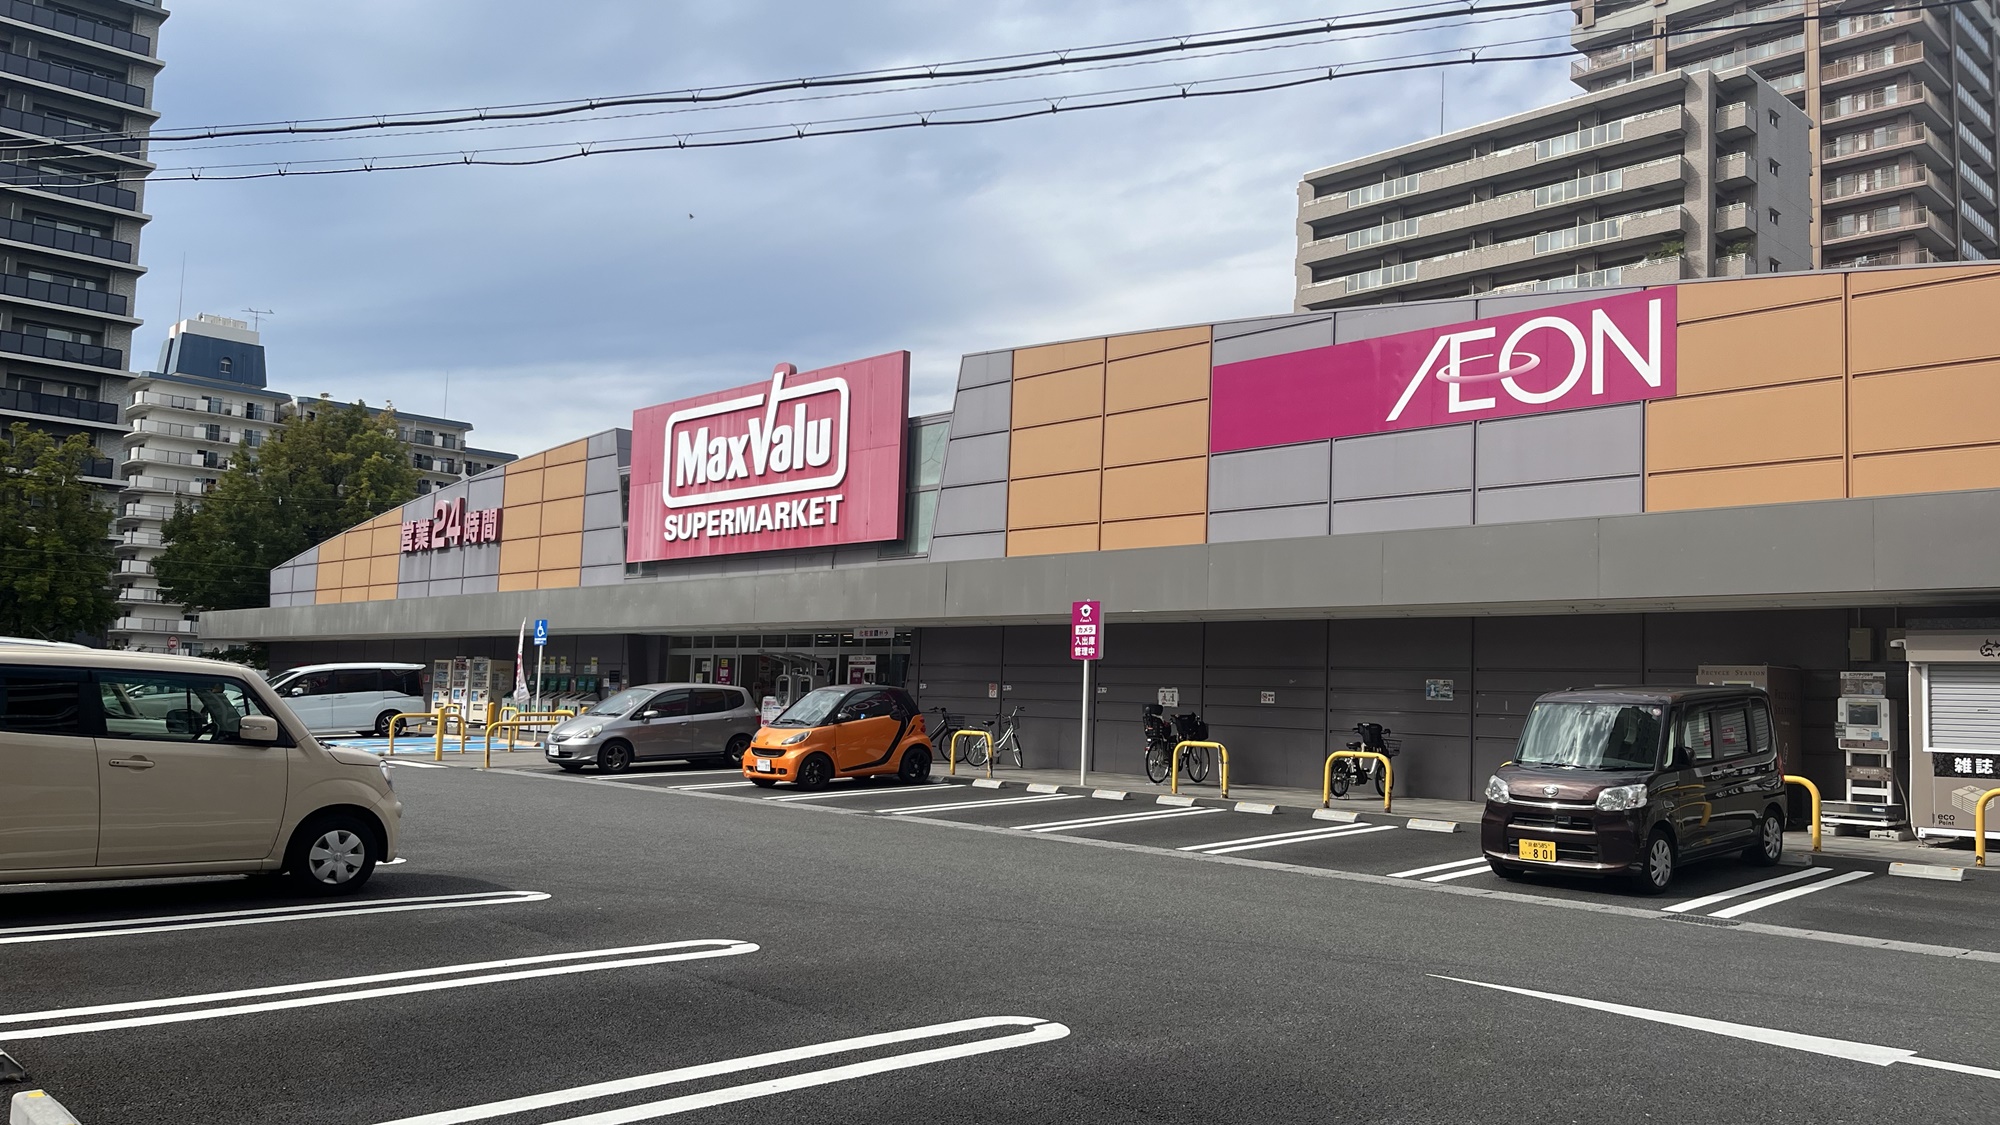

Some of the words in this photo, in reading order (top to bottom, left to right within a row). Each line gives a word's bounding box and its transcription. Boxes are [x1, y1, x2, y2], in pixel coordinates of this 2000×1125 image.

[675, 373, 833, 487] MaxValu
[663, 493, 843, 542] SUPERMARKET
[1077, 626, 1094, 634] カメラ
[1074, 636, 1096, 646] 入出庫
[1074, 646, 1096, 656] 管理中
[1954, 757, 1994, 775] 雑誌
